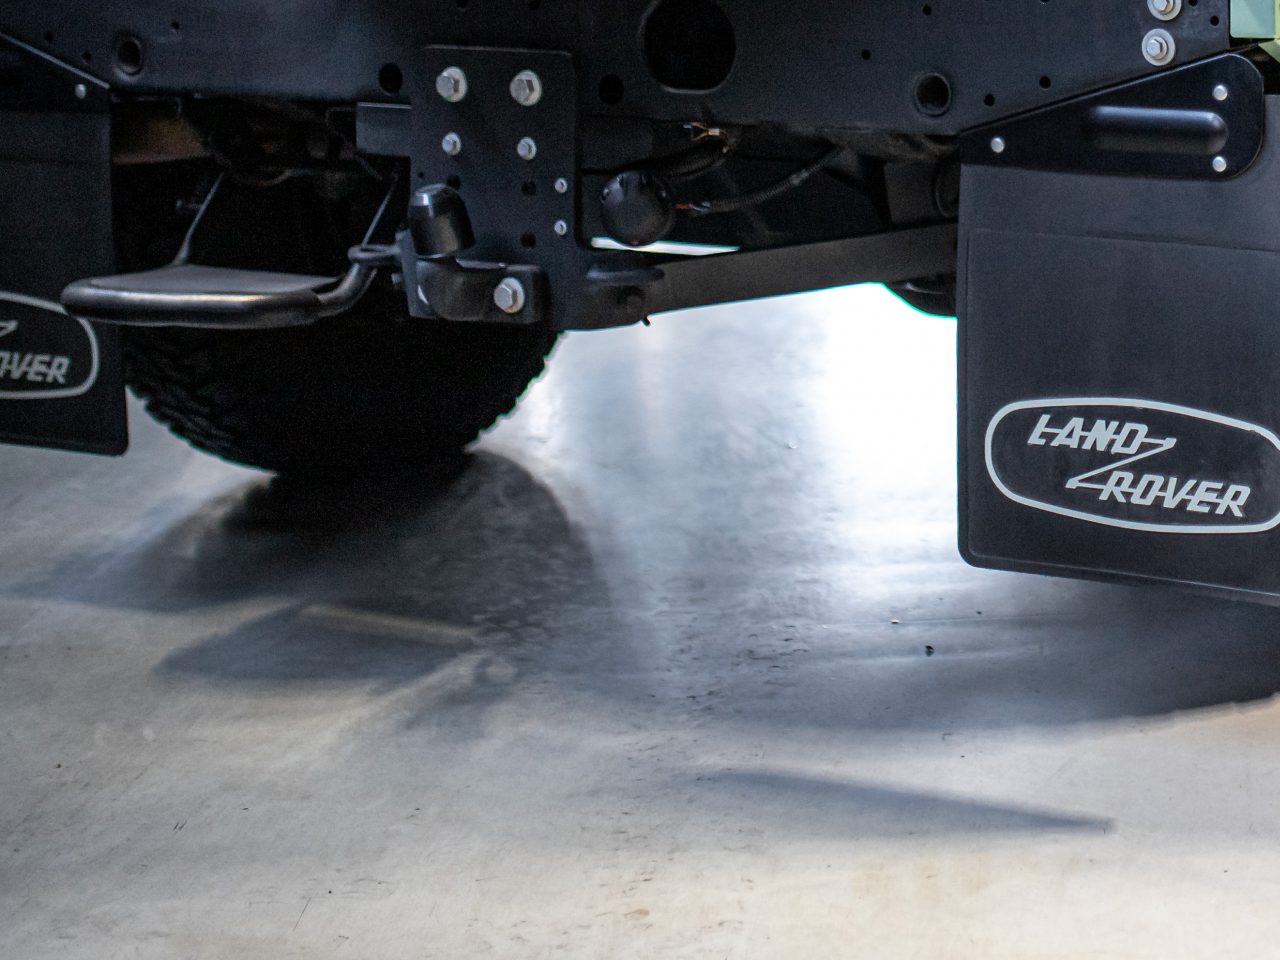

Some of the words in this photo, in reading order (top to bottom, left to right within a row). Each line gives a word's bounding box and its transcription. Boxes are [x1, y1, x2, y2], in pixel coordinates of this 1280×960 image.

[0, 351, 70, 384] OVER
[1027, 413, 1149, 455] LAND
[1099, 470, 1251, 519] ROVER
